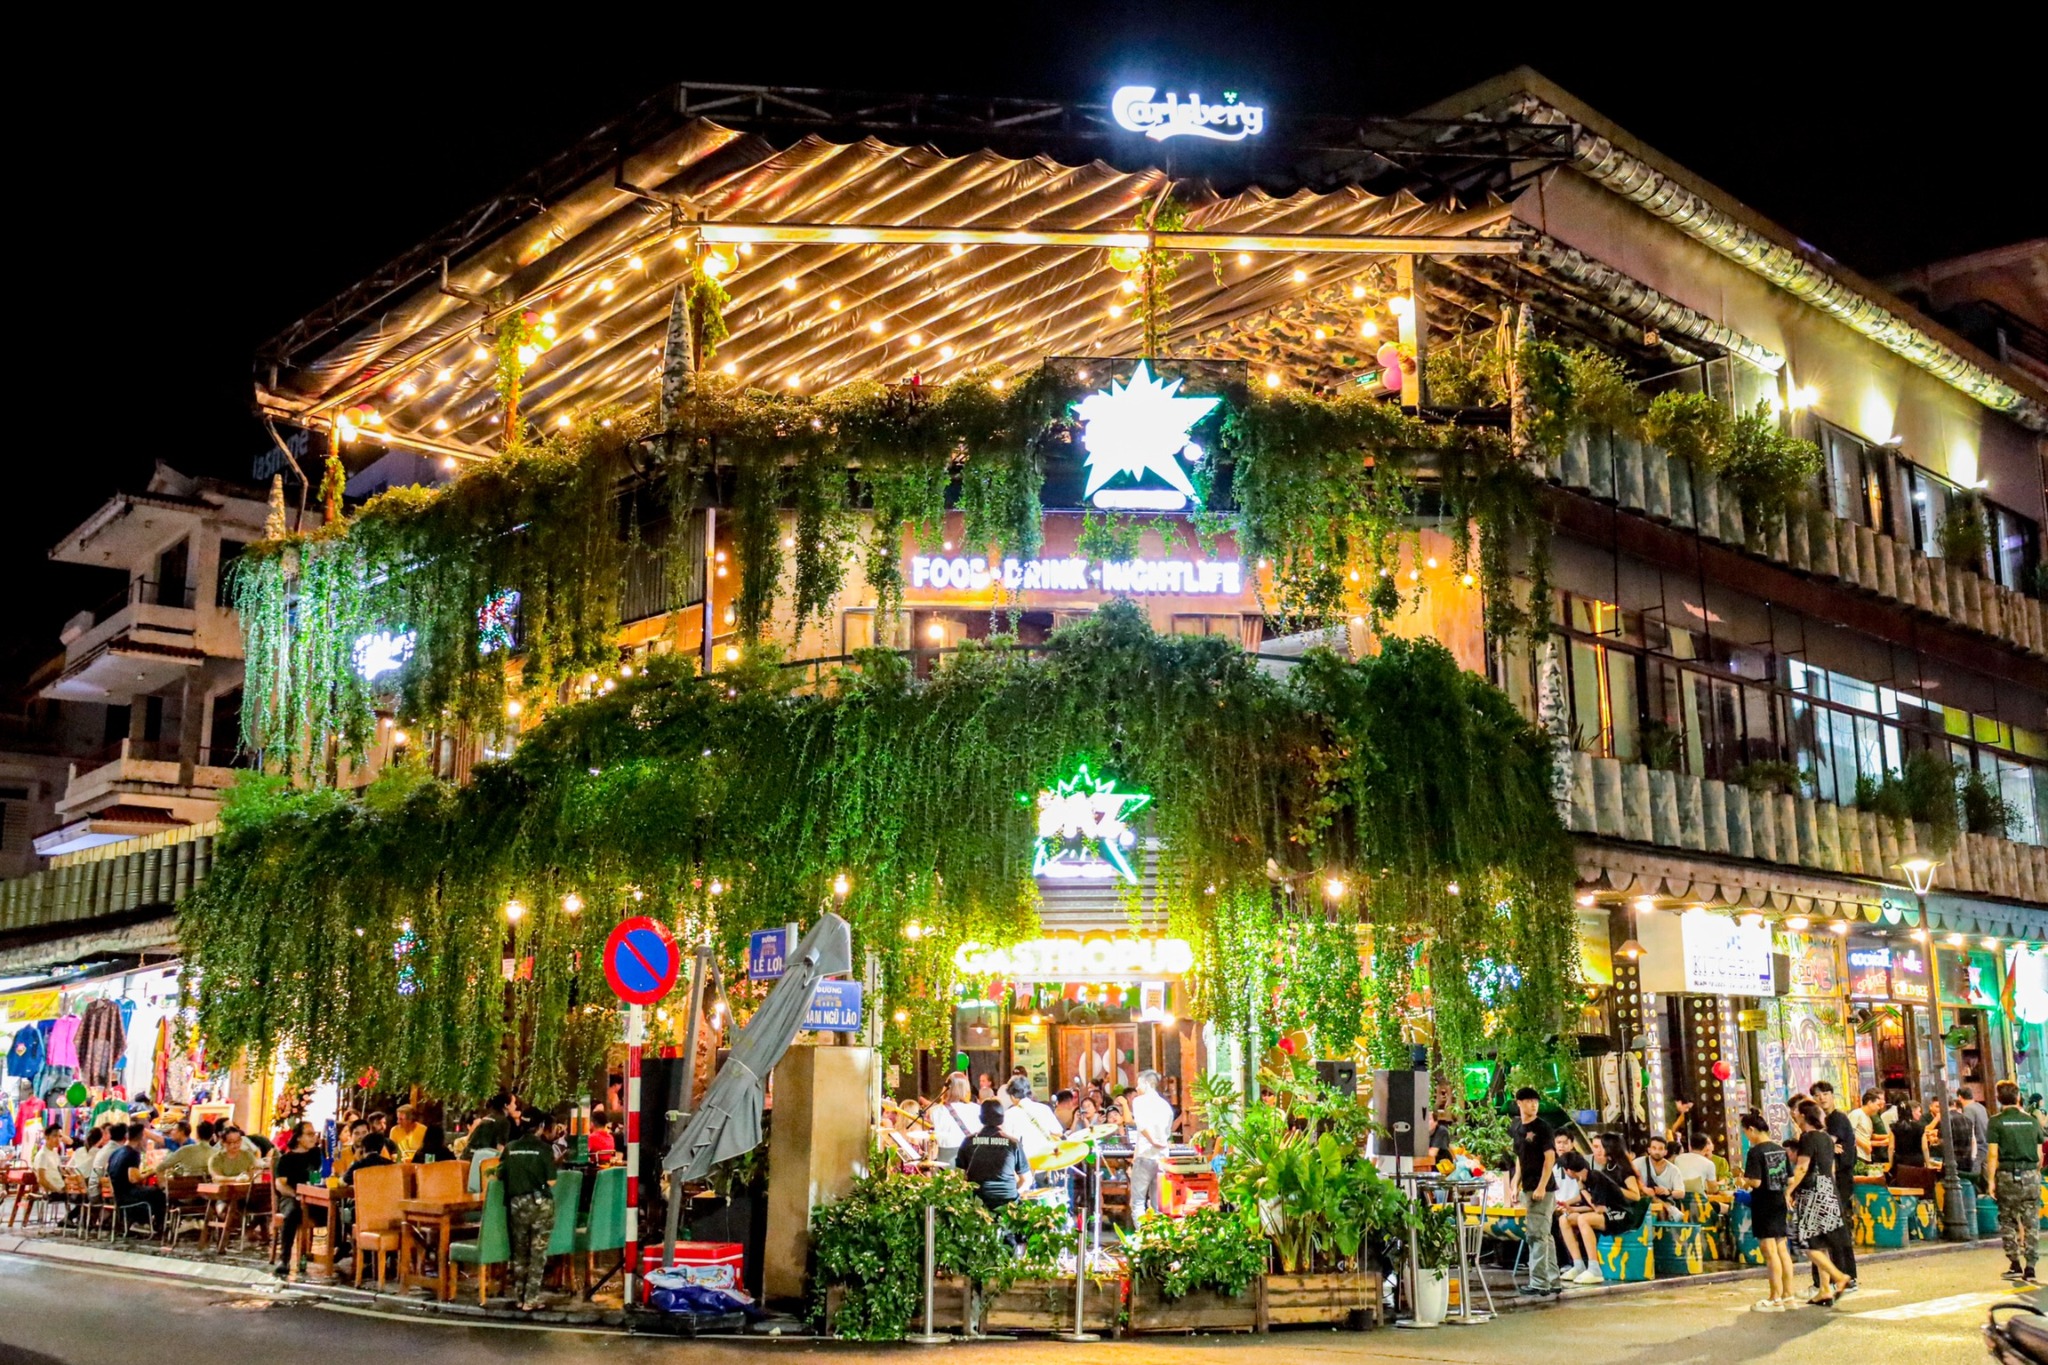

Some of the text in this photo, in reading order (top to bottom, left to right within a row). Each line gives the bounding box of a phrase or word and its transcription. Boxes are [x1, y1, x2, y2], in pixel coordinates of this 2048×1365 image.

[1112, 86, 1263, 141] Carlsberg
[1004, 558, 1087, 590] DRINK
[1102, 559, 1241, 594] NIGHTLIFE
[972, 1136, 1010, 1147] DRUM HOUSE
